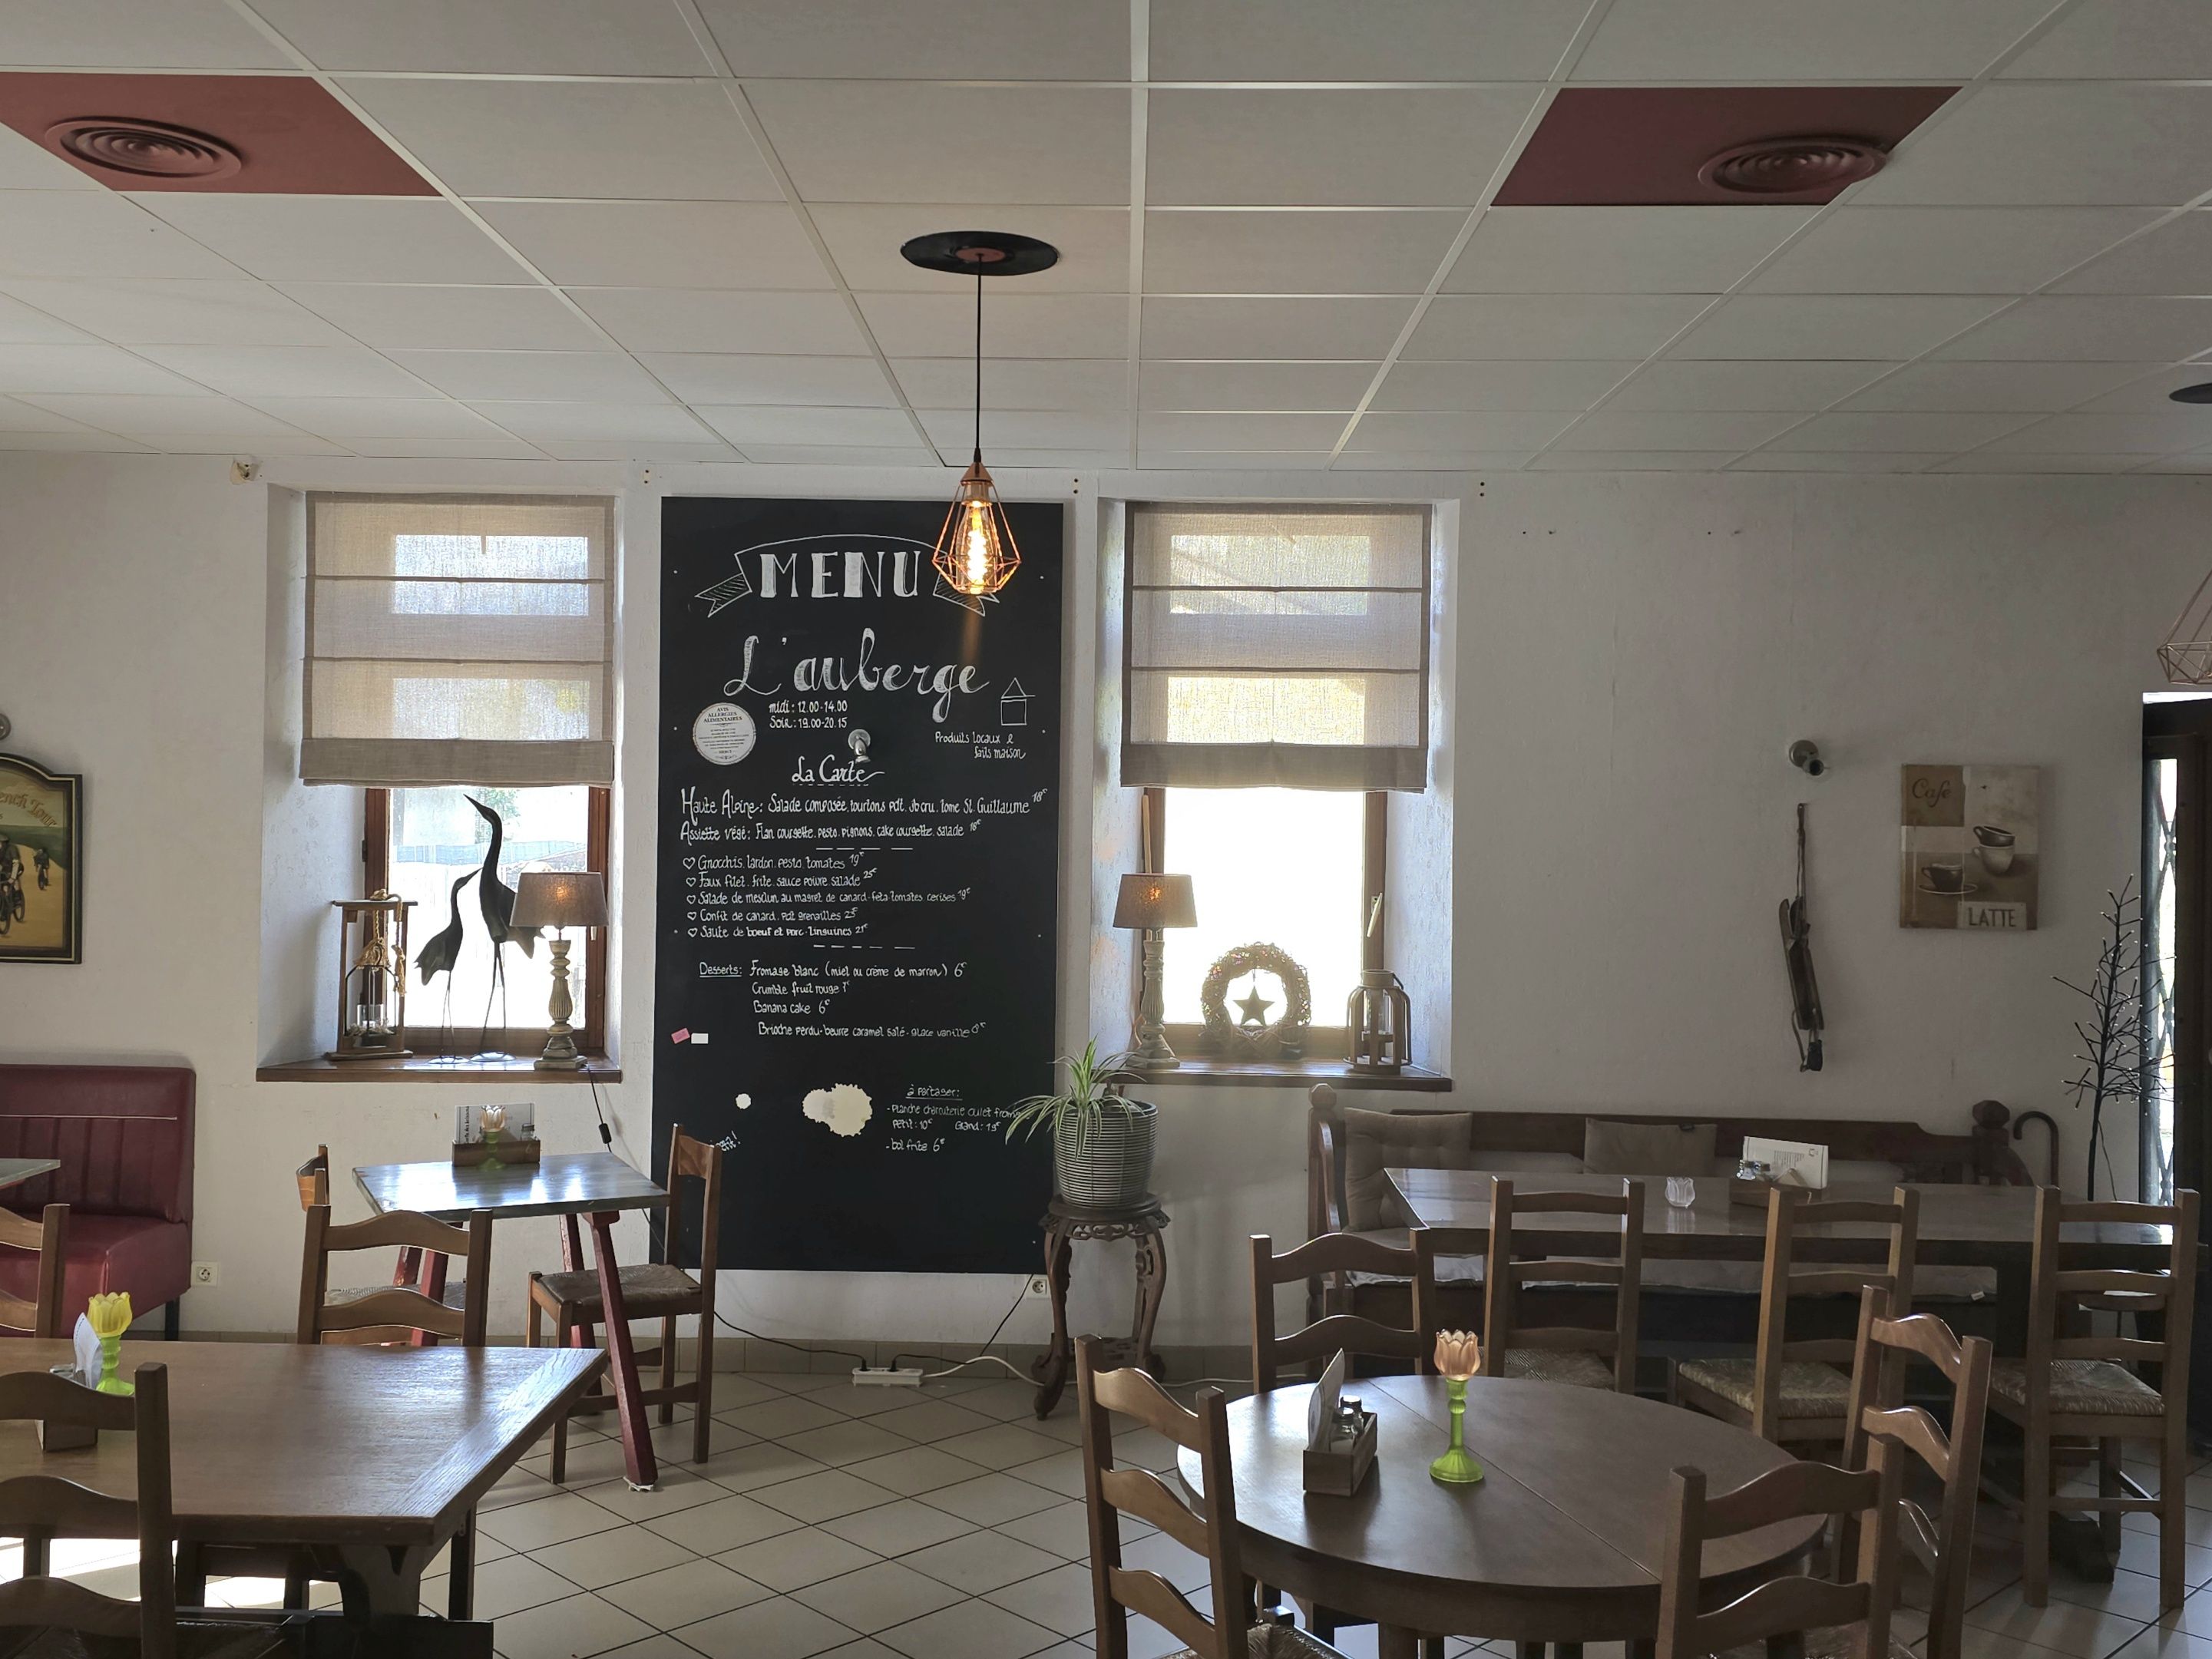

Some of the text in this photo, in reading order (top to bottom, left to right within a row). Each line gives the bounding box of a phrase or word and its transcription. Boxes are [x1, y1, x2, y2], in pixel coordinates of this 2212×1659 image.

[760, 551, 921, 598] MENU
[723, 628, 990, 723] L'auberge
[792, 754, 884, 782] La Carte
[681, 786, 717, 827] Haute
[768, 793, 802, 812] Salade
[850, 799, 885, 812] tourtons
[977, 797, 1030, 814] Guillaume
[680, 820, 720, 846] Assiette
[877, 825, 894, 837] cake
[937, 825, 964, 836] salade
[805, 856, 845, 869] tomates
[699, 871, 721, 887] Faux
[776, 877, 801, 887] sauce
[832, 874, 860, 886] salade
[698, 891, 728, 904] Salade
[732, 891, 743, 904] de
[781, 894, 792, 902] au
[826, 894, 835, 902] de
[700, 909, 728, 921] Confit
[732, 912, 743, 921] de
[1968, 907, 2017, 927] LATTE
[733, 927, 744, 937] de
[746, 927, 772, 937] boeuf
[774, 927, 783, 936] et
[749, 960, 789, 976] Fromage
[792, 964, 818, 976] blanc
[853, 968, 862, 977] ou
[894, 967, 905, 977] de
[815, 986, 839, 994] rouge
[753, 1000, 787, 1013] Banana
[790, 1003, 811, 1014] cake
[759, 1022, 792, 1035] Brioche
[853, 1026, 884, 1036] caramel
